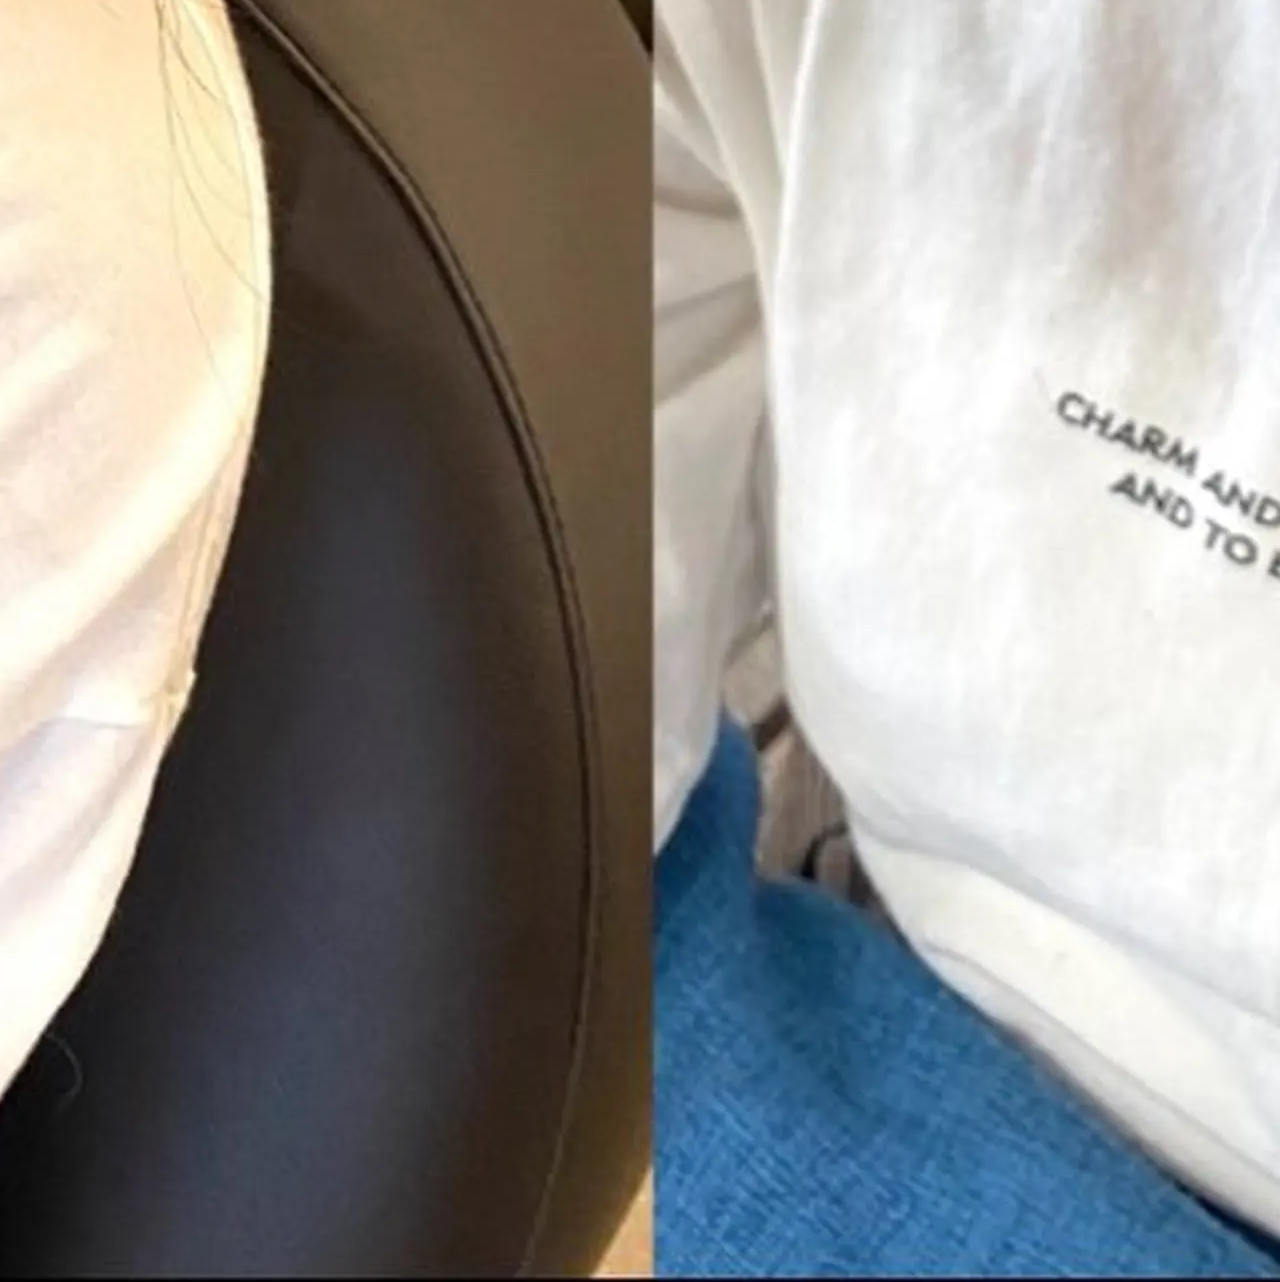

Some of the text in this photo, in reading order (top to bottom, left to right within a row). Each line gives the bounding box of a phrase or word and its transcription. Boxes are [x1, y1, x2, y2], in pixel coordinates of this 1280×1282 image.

[1056, 392, 1200, 477] CHARM
[1109, 473, 1194, 530] AND
[1204, 519, 1259, 566] TO
